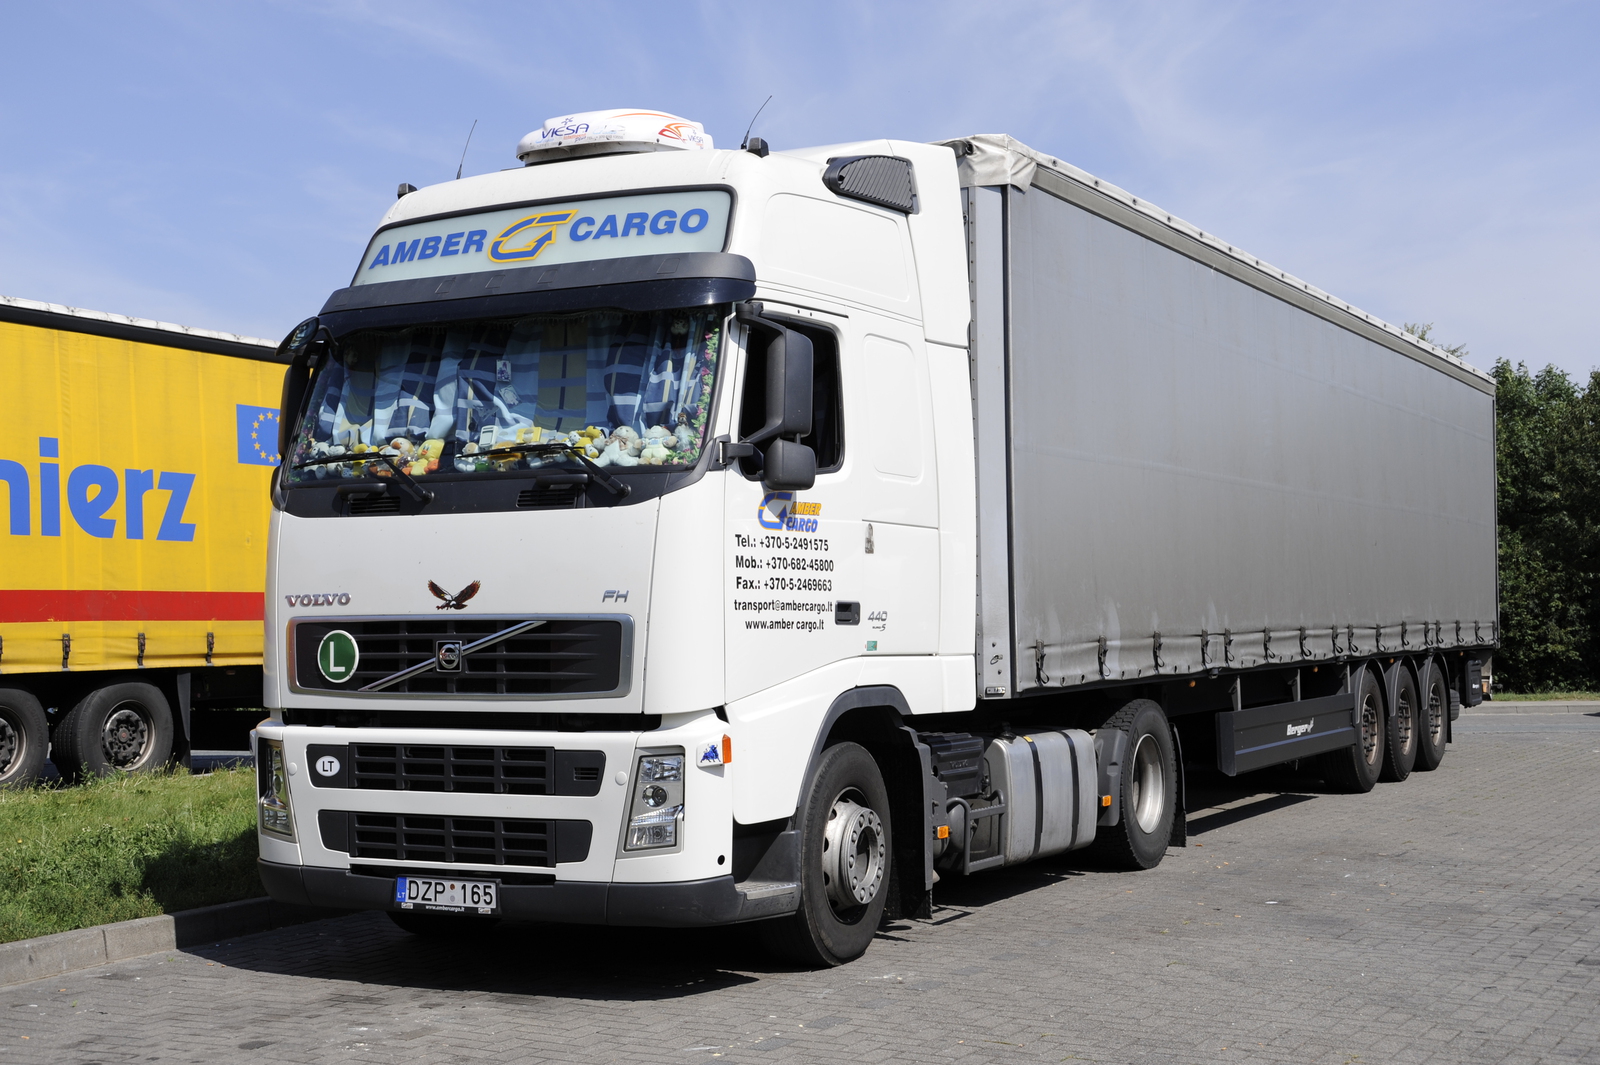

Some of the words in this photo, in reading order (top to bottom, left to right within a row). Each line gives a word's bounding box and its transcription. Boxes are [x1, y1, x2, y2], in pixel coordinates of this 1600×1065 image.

[542, 123, 589, 139] VIESA
[368, 229, 488, 270] AMBER
[568, 207, 709, 242] CARGO
[789, 501, 822, 516] AMBER
[786, 516, 818, 533] CARGO
[735, 534, 756, 548] Tel.:
[760, 535, 829, 551] +370-5-2491575
[735, 555, 763, 569] Mob.:
[766, 556, 834, 572] +370-682-45800
[736, 576, 760, 590] Fax.:
[764, 577, 832, 591] +370-5-2469663
[285, 592, 351, 608] VOLVO
[602, 589, 629, 603] FH
[734, 599, 833, 615] transport@ambercargo.lt
[868, 610, 888, 621] 440
[329, 641, 346, 672] L
[322, 760, 335, 773] LT
[408, 880, 446, 902] DZP
[461, 883, 493, 905] 165
